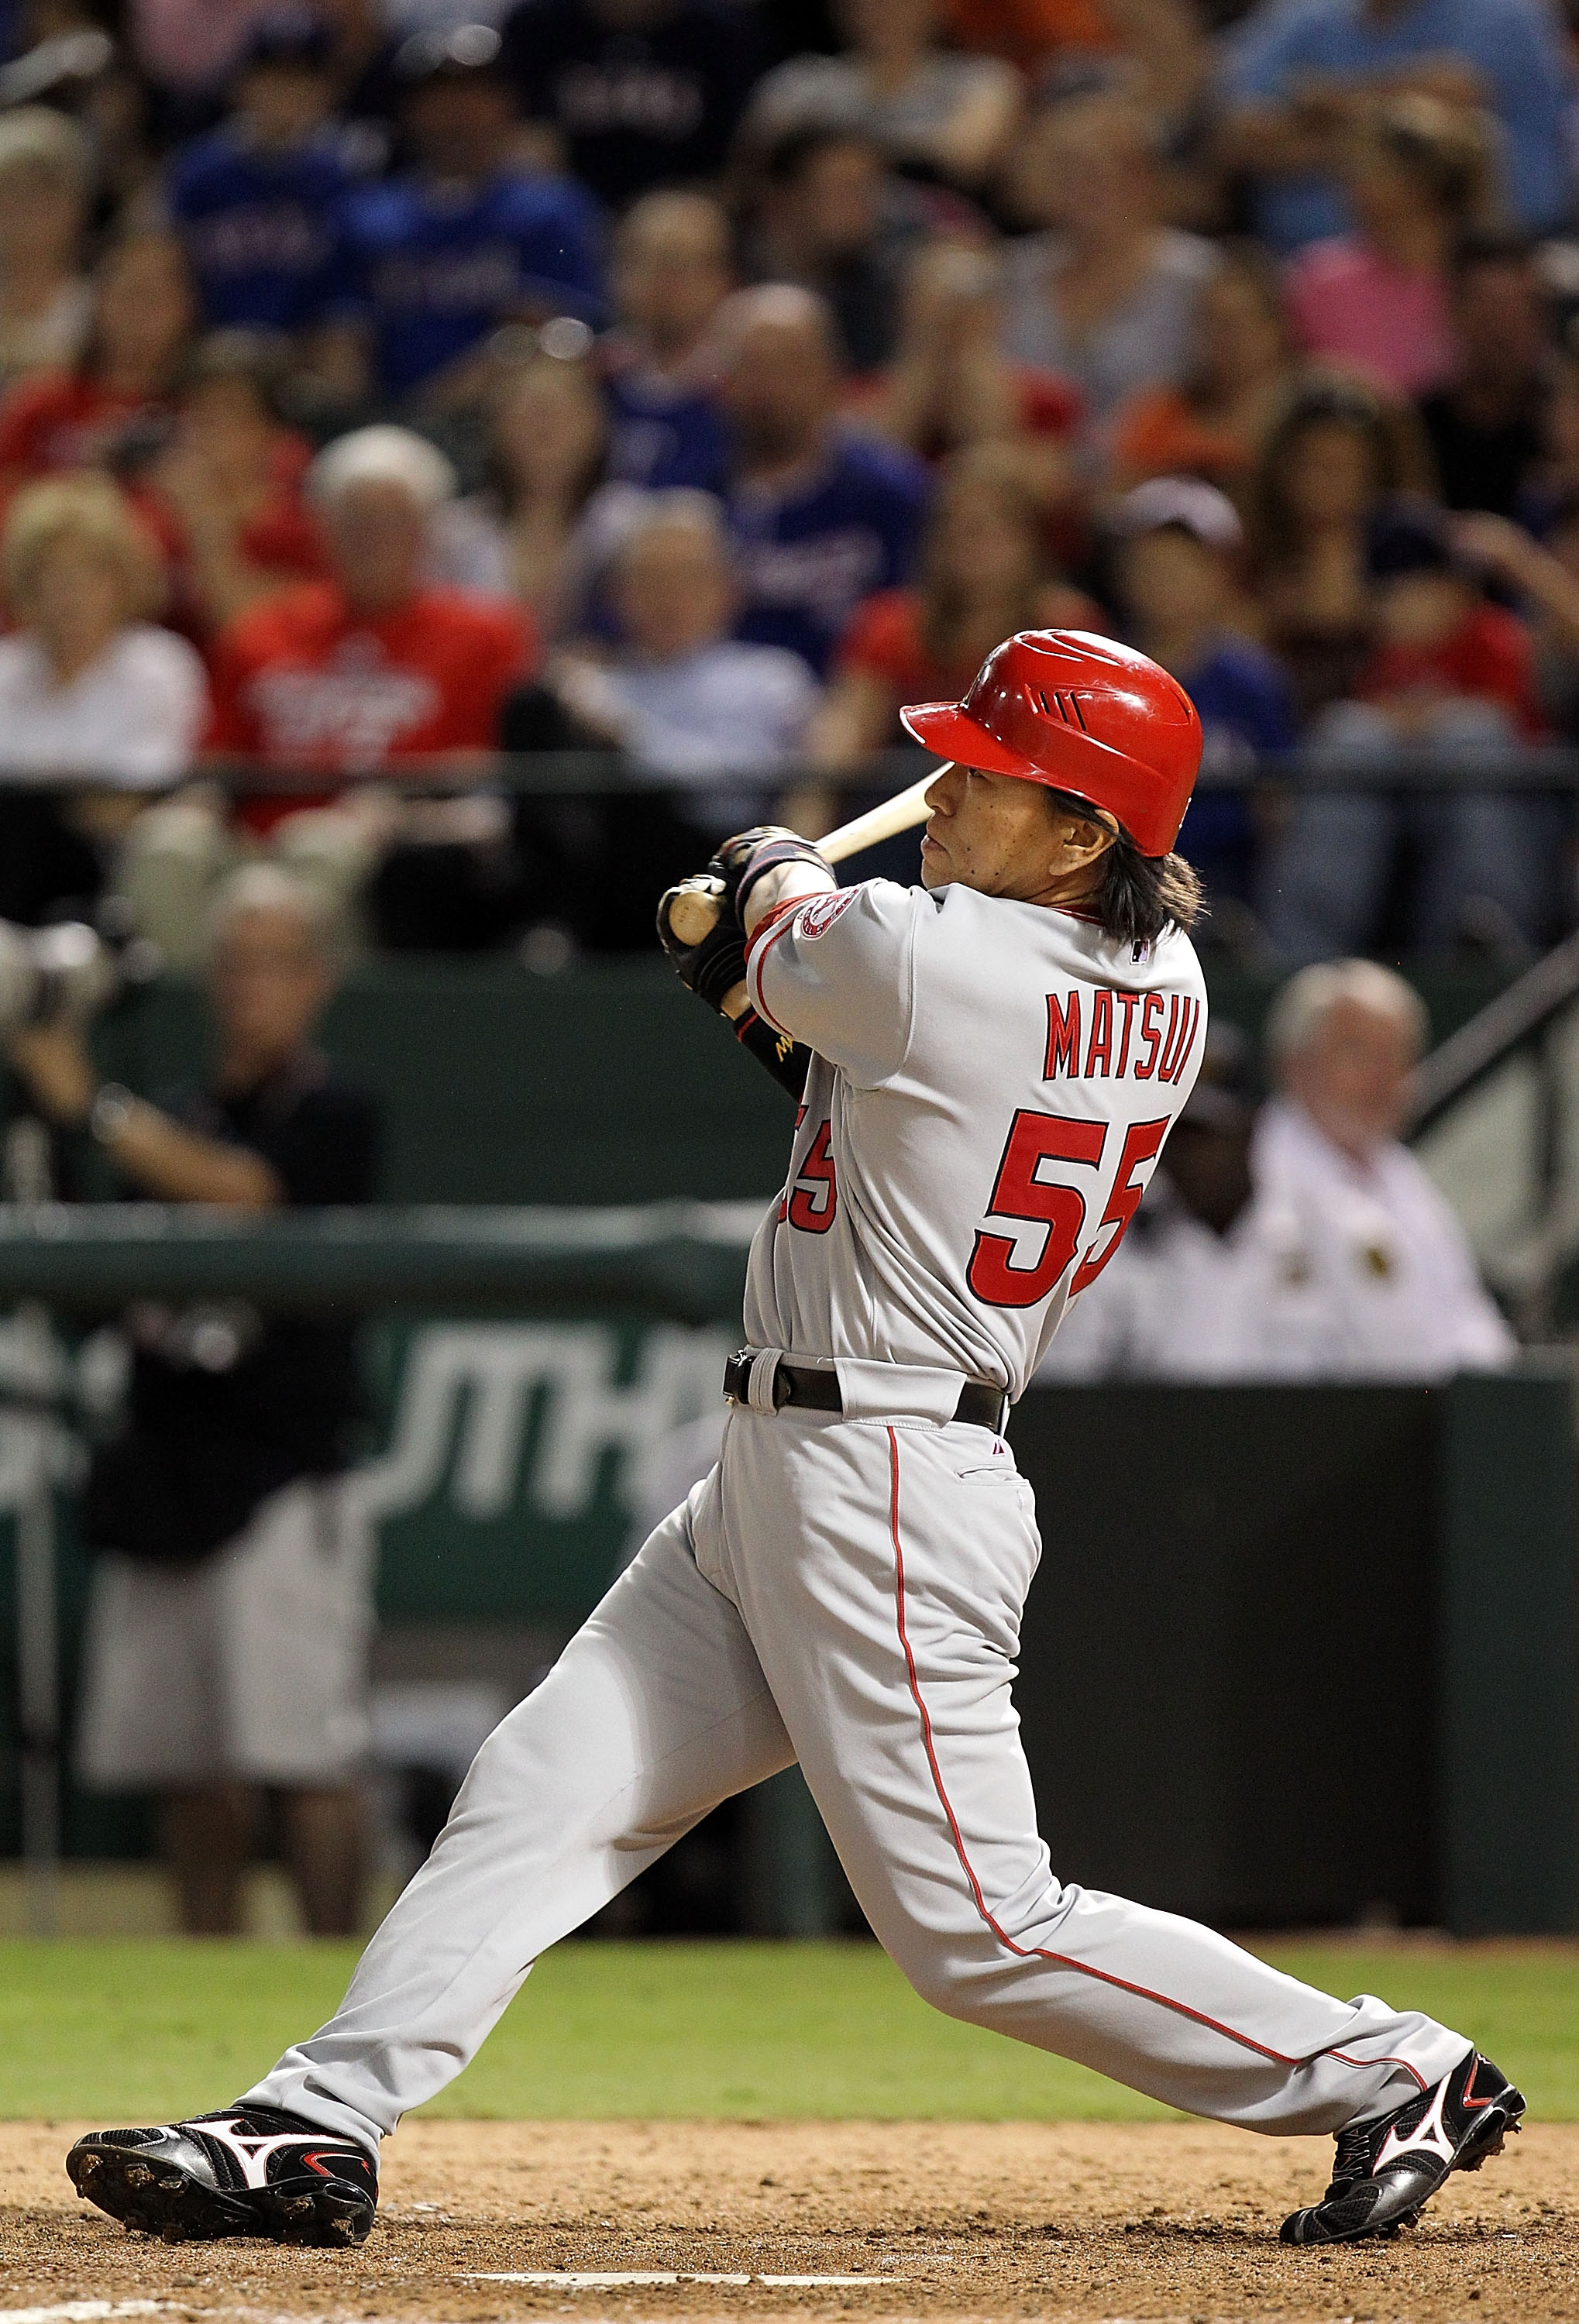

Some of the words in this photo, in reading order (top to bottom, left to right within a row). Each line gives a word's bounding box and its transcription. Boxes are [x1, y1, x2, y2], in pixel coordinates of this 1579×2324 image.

[1044, 990, 1200, 1085] MATSUI
[777, 1104, 837, 1235] 5
[966, 1109, 1172, 1308] 55
